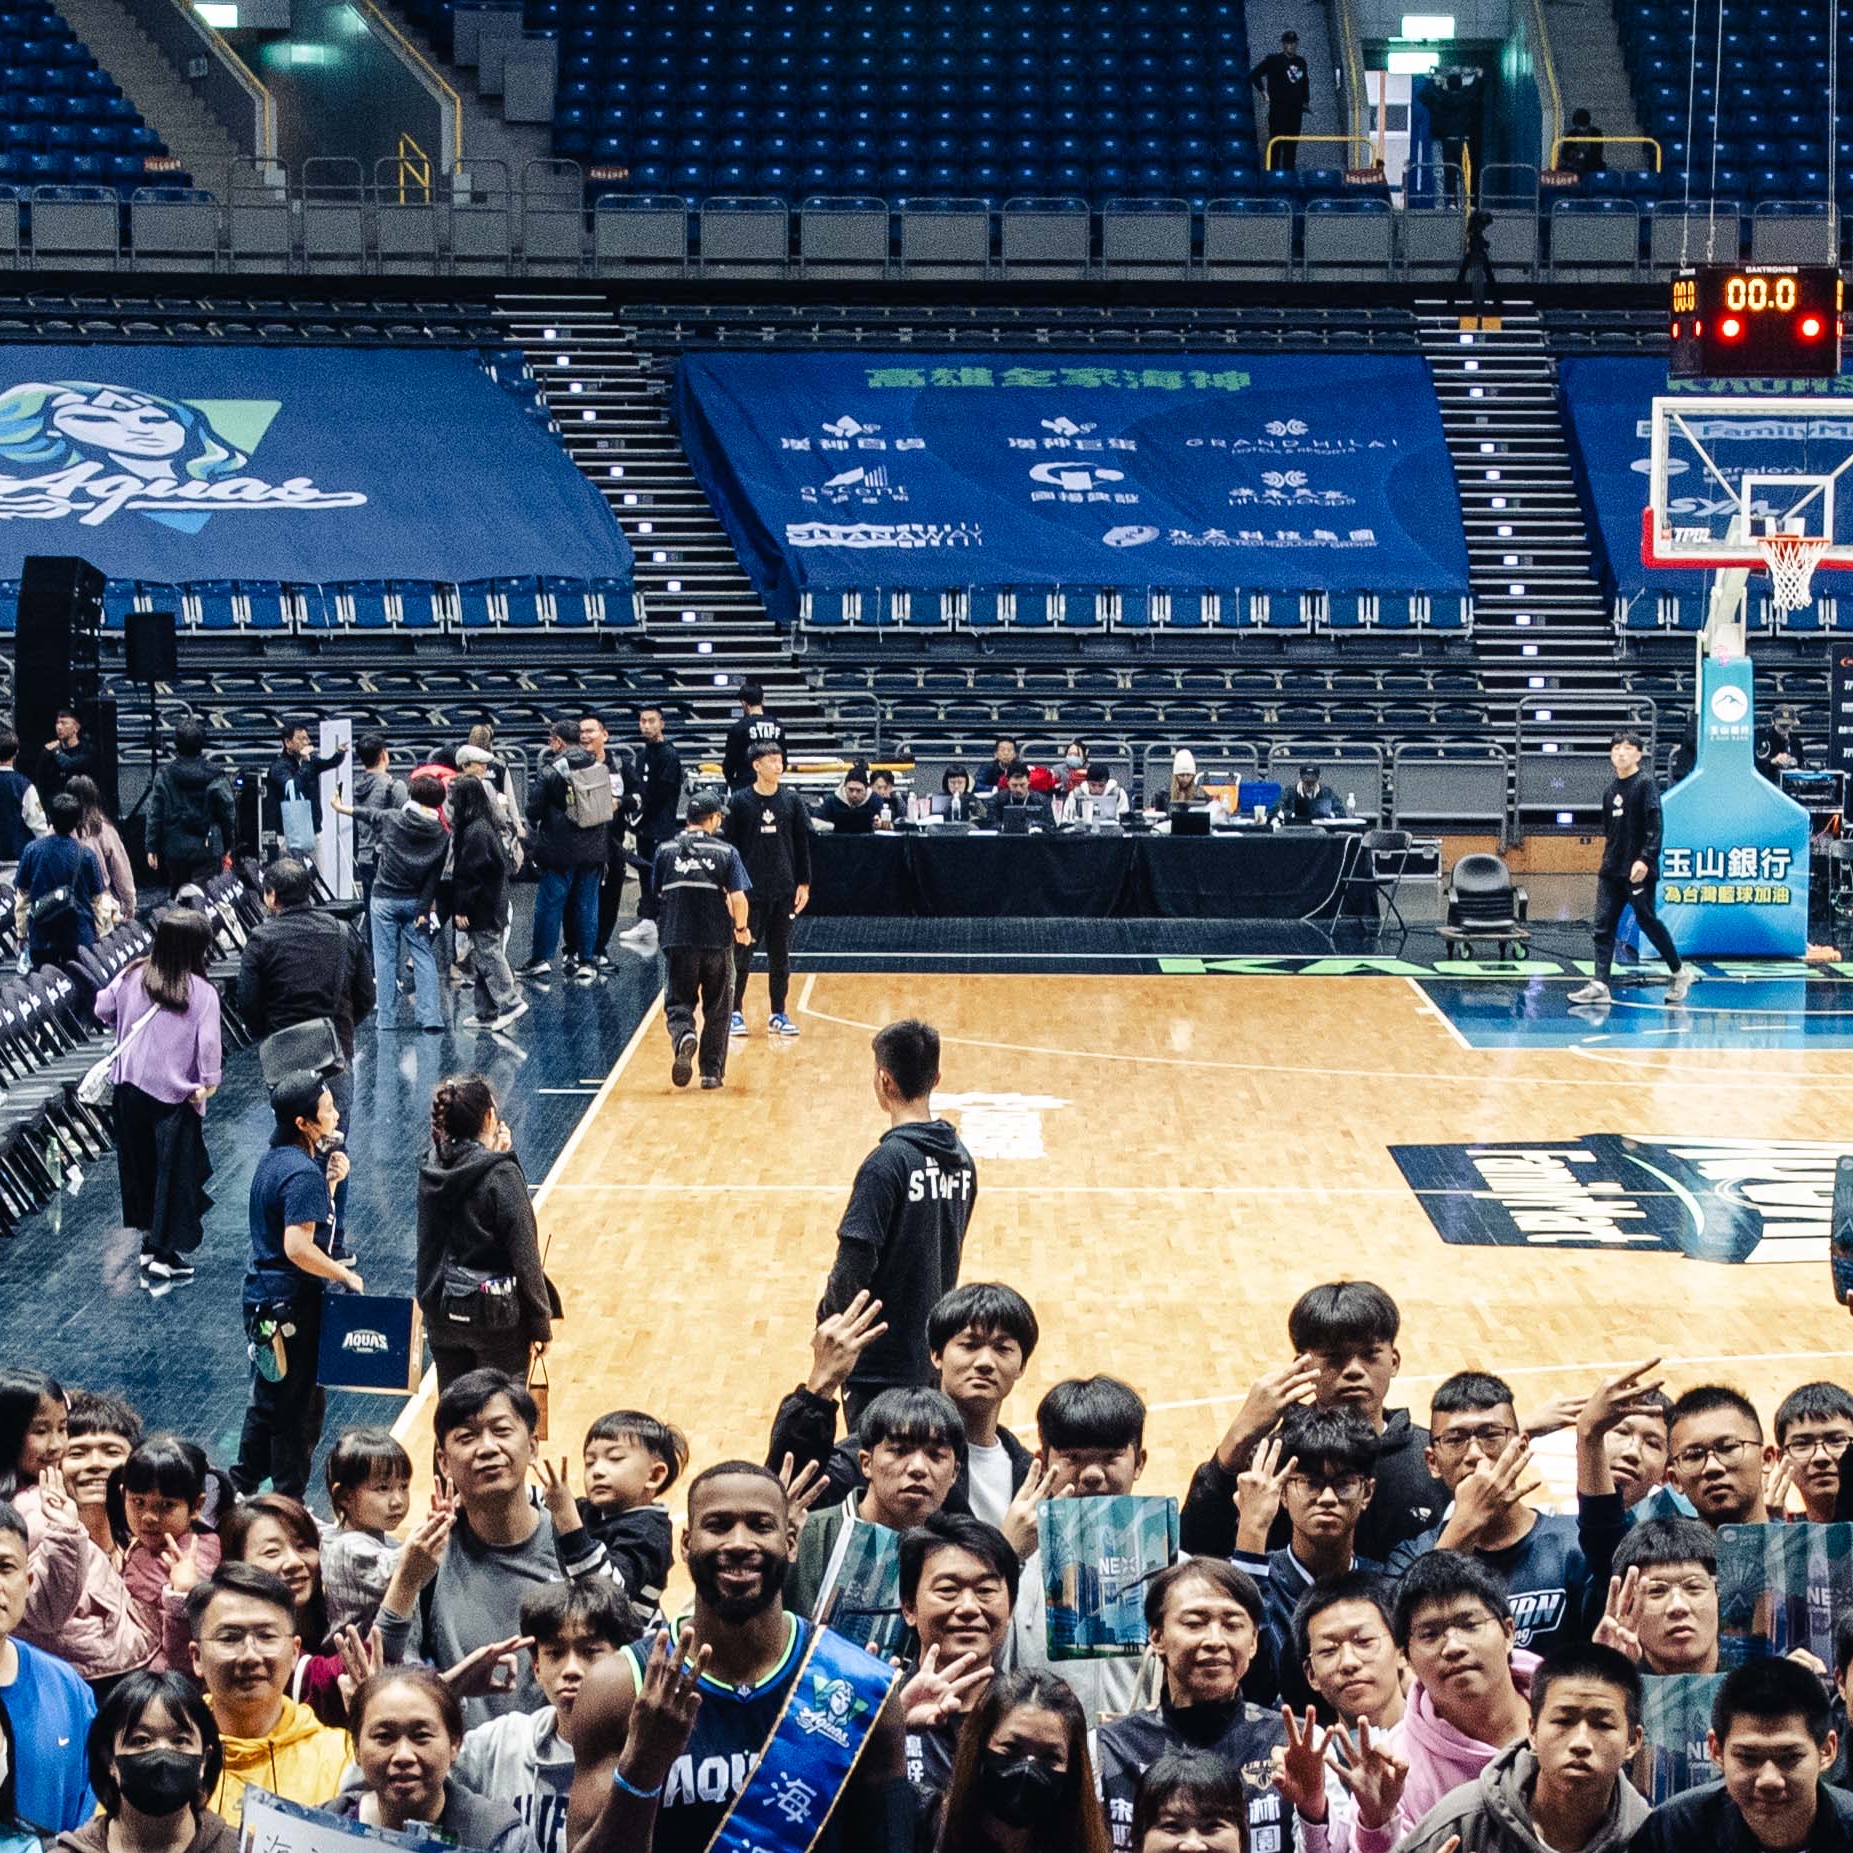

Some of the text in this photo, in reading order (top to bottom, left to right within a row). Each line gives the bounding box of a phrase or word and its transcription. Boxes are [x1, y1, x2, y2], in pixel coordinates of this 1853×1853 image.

[1725, 276, 1797, 312] 00.0
[865, 367, 1251, 392] 高雄全家海神
[749, 726, 781, 740] STAFF
[1663, 848, 1791, 880] 玉山銀行
[1664, 886, 1791, 905] 為台灣籃球加油
[907, 1167, 972, 1202] STAFF
[341, 1331, 389, 1350] AQUAS
[1097, 1556, 1138, 1576] NEX
[795, 1702, 851, 1749] Aquas
[661, 1751, 756, 1808] AQU
